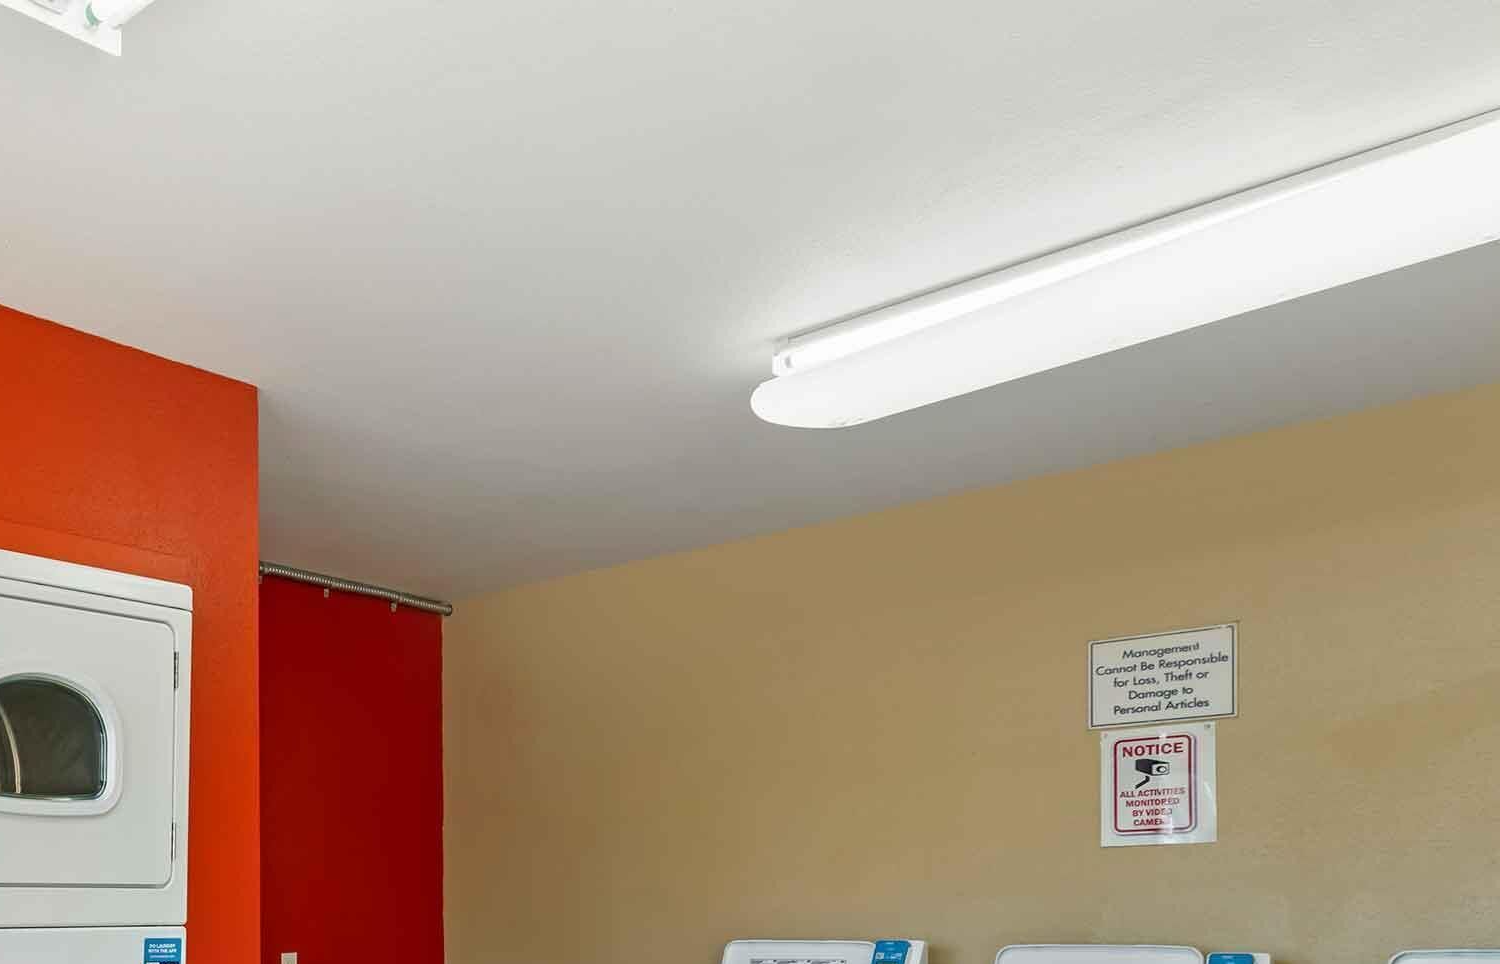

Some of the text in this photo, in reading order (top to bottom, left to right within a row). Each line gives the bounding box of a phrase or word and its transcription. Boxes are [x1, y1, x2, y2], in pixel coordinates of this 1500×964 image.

[1122, 642, 1199, 659] Management
[1095, 652, 1229, 676] Cannot Be Responsible
[1113, 669, 1209, 688] for Loss, Theft or
[1128, 686, 1194, 701] Damage to
[1113, 697, 1210, 715] Personal Articles
[1122, 742, 1184, 757] NOTICE
[1138, 787, 1186, 797] ACTIVITIES
[1125, 798, 1180, 807] MONITORED
